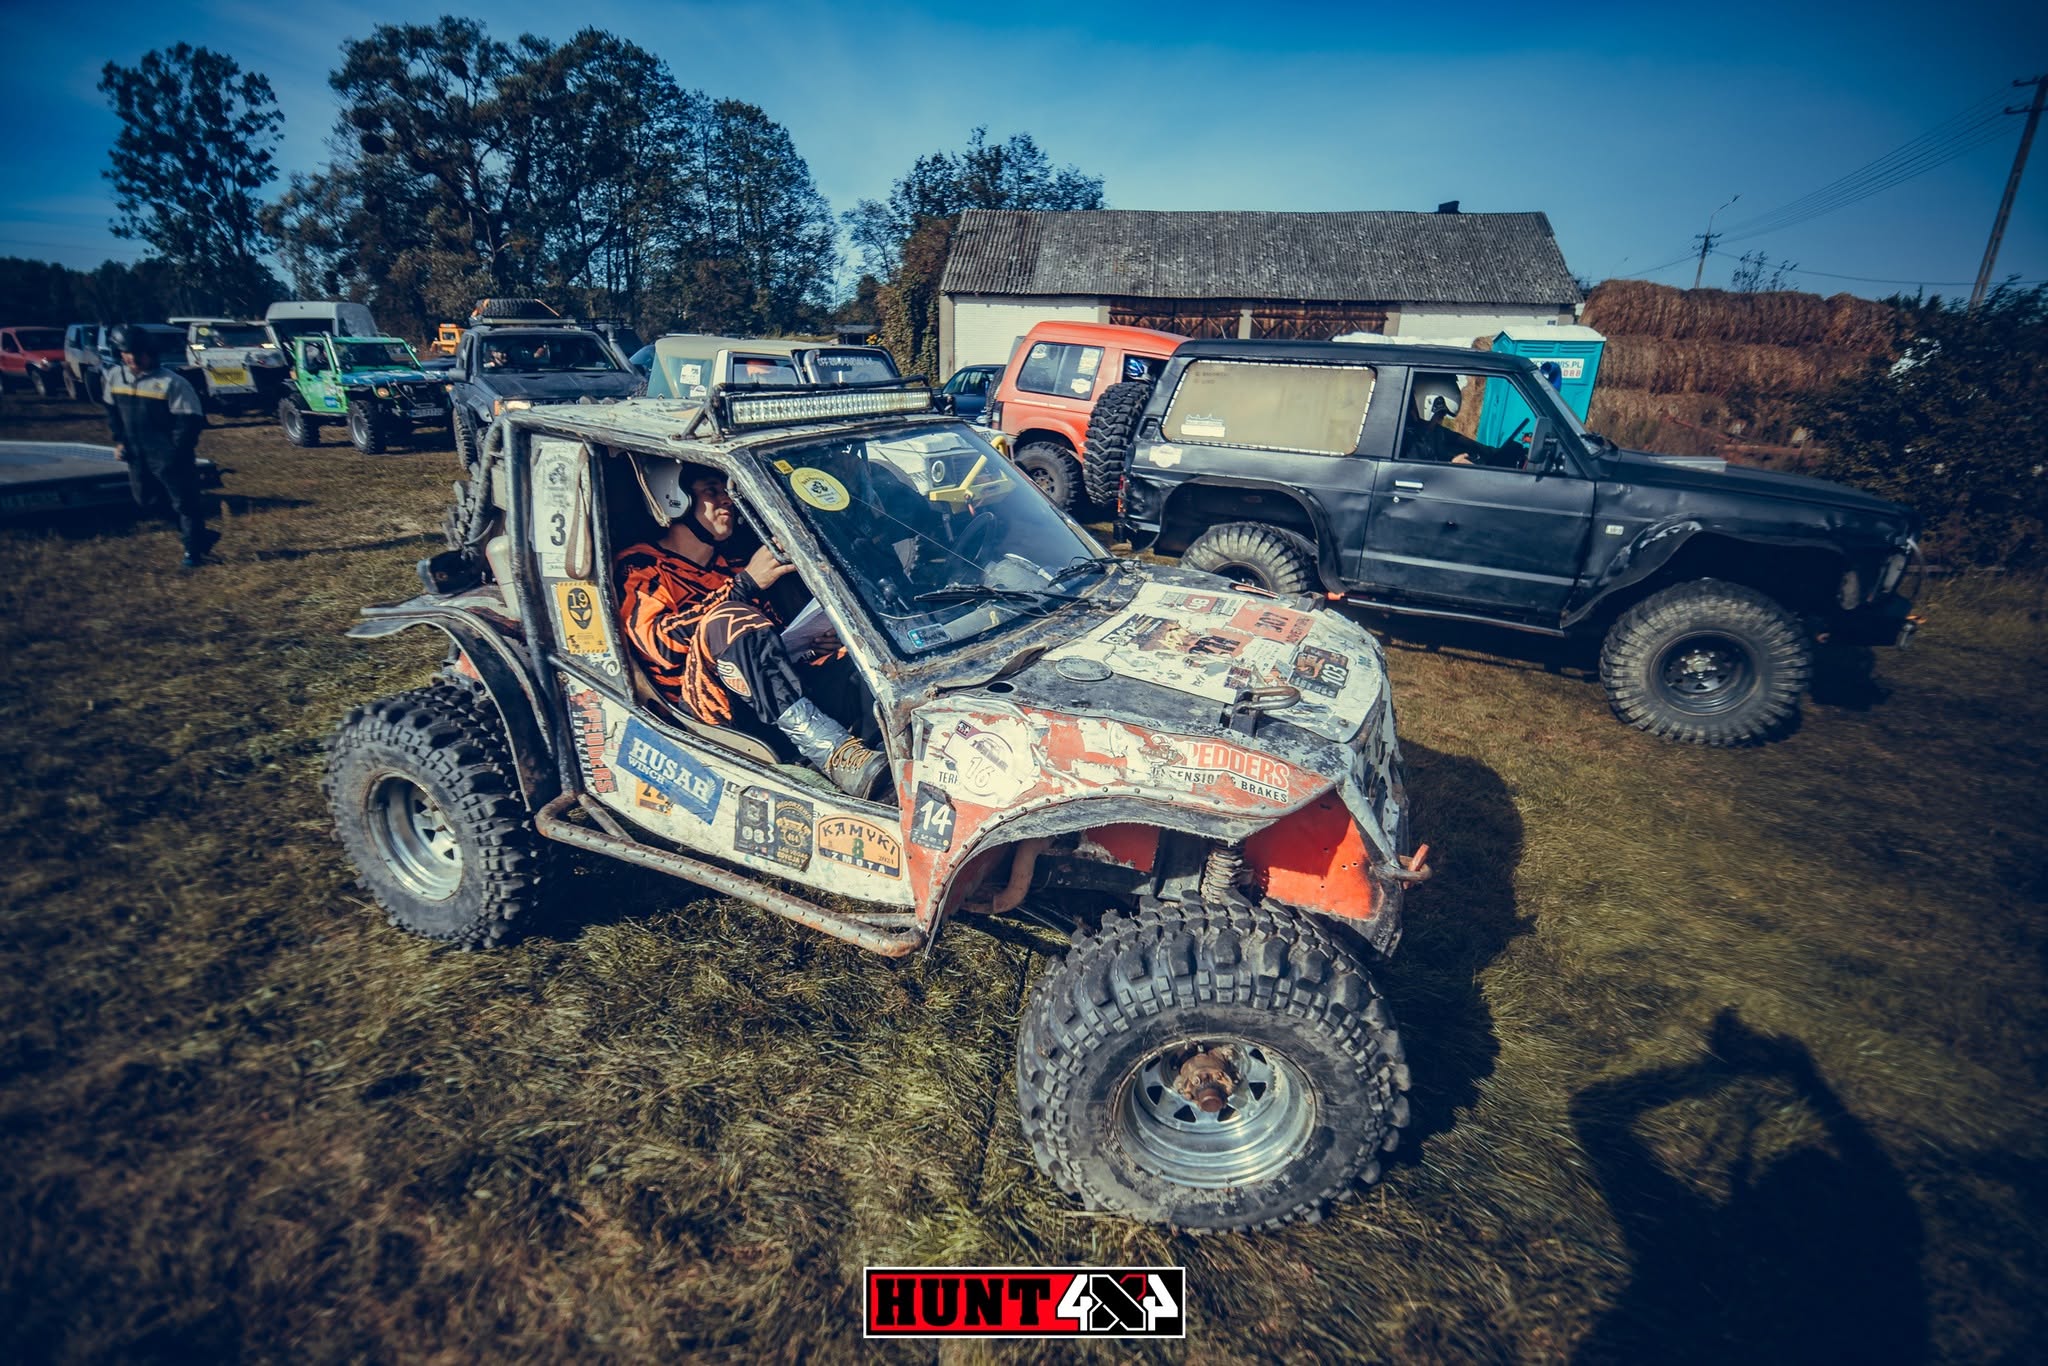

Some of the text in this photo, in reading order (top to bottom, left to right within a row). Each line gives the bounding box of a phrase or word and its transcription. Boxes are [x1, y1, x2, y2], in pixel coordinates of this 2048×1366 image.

[550, 513, 567, 547] 3
[568, 591, 589, 609] 19
[1321, 663, 1347, 686] 103
[628, 755, 666, 785] WINCH
[628, 737, 710, 804] HUSAR
[966, 757, 995, 789] 16
[1241, 780, 1288, 804] BRAKES
[920, 799, 952, 836] 14
[822, 822, 896, 856] KAMYKI
[851, 838, 864, 859] 8
